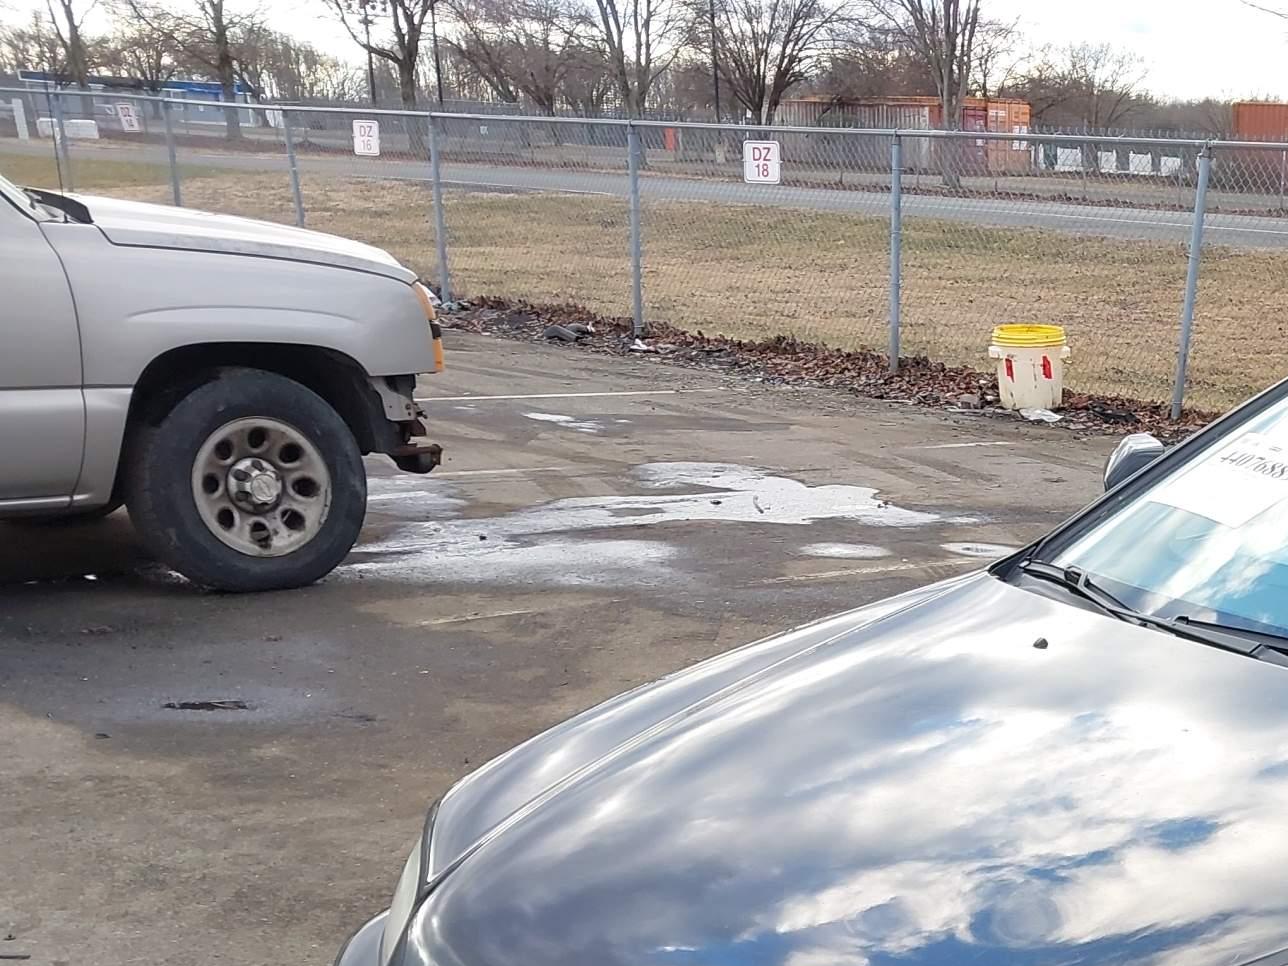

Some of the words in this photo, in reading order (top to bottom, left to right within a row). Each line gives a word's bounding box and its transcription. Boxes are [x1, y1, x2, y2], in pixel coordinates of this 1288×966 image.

[360, 125, 373, 137] DZ
[361, 139, 372, 151] 16
[752, 147, 772, 161] DZ
[755, 163, 769, 177] 18
